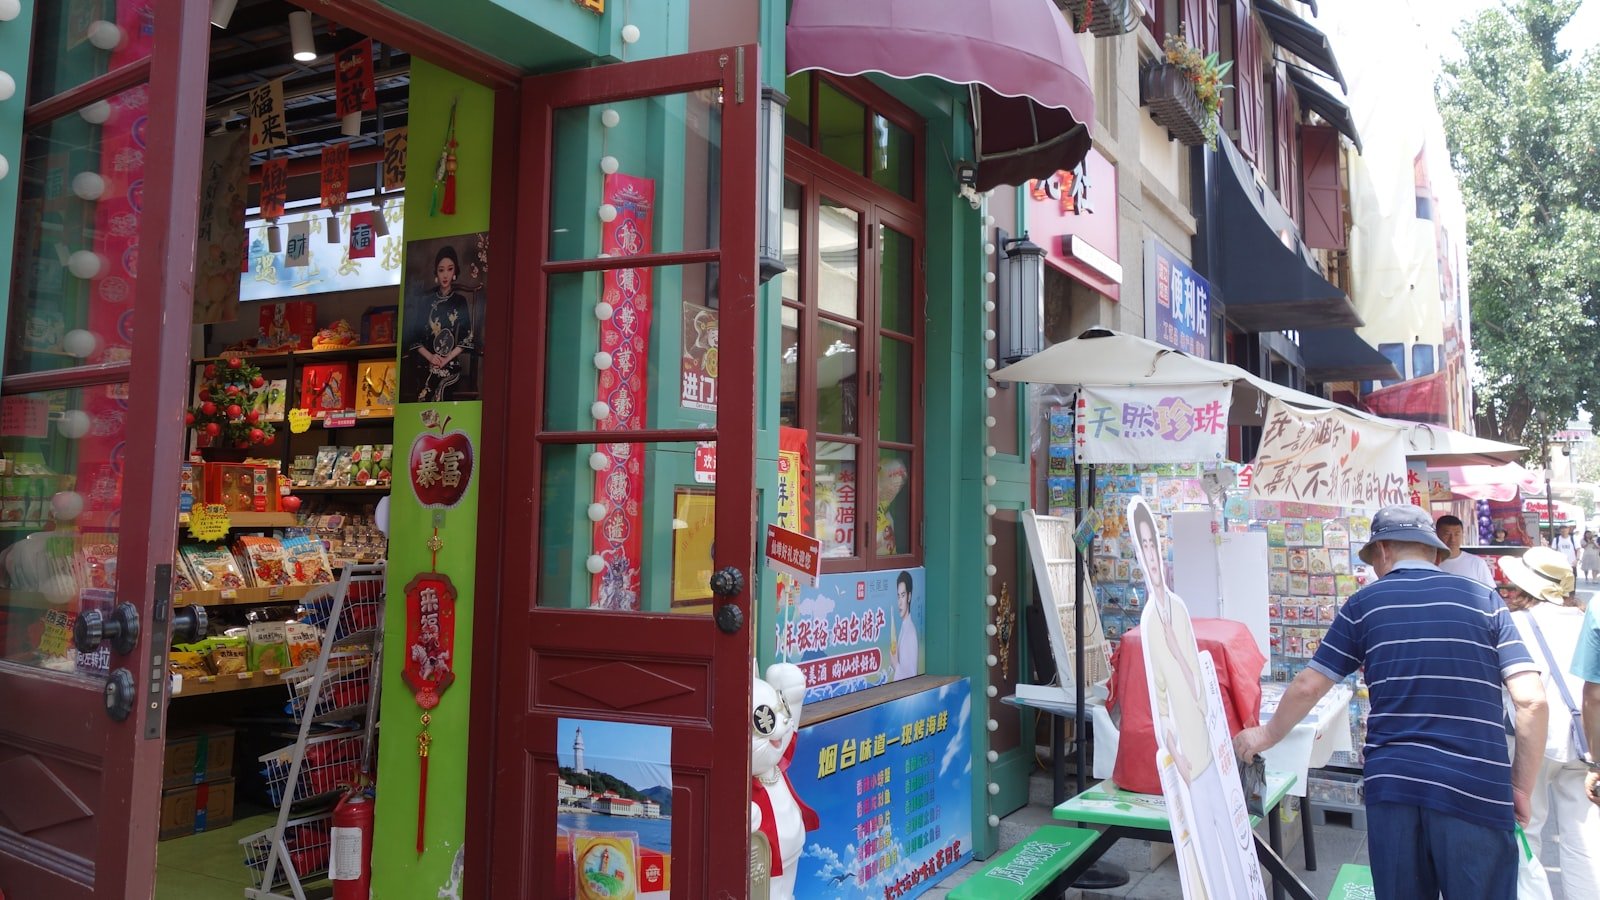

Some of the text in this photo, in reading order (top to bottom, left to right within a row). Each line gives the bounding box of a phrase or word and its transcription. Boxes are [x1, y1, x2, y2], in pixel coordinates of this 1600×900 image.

[352, 225, 372, 248] 福
[1171, 263, 1207, 337] 便利店
[682, 371, 717, 404] 进门
[1088, 398, 1225, 441] 天然珍珠
[416, 448, 465, 488] 暴富
[775, 609, 885, 654] 年张裕 烟台特产
